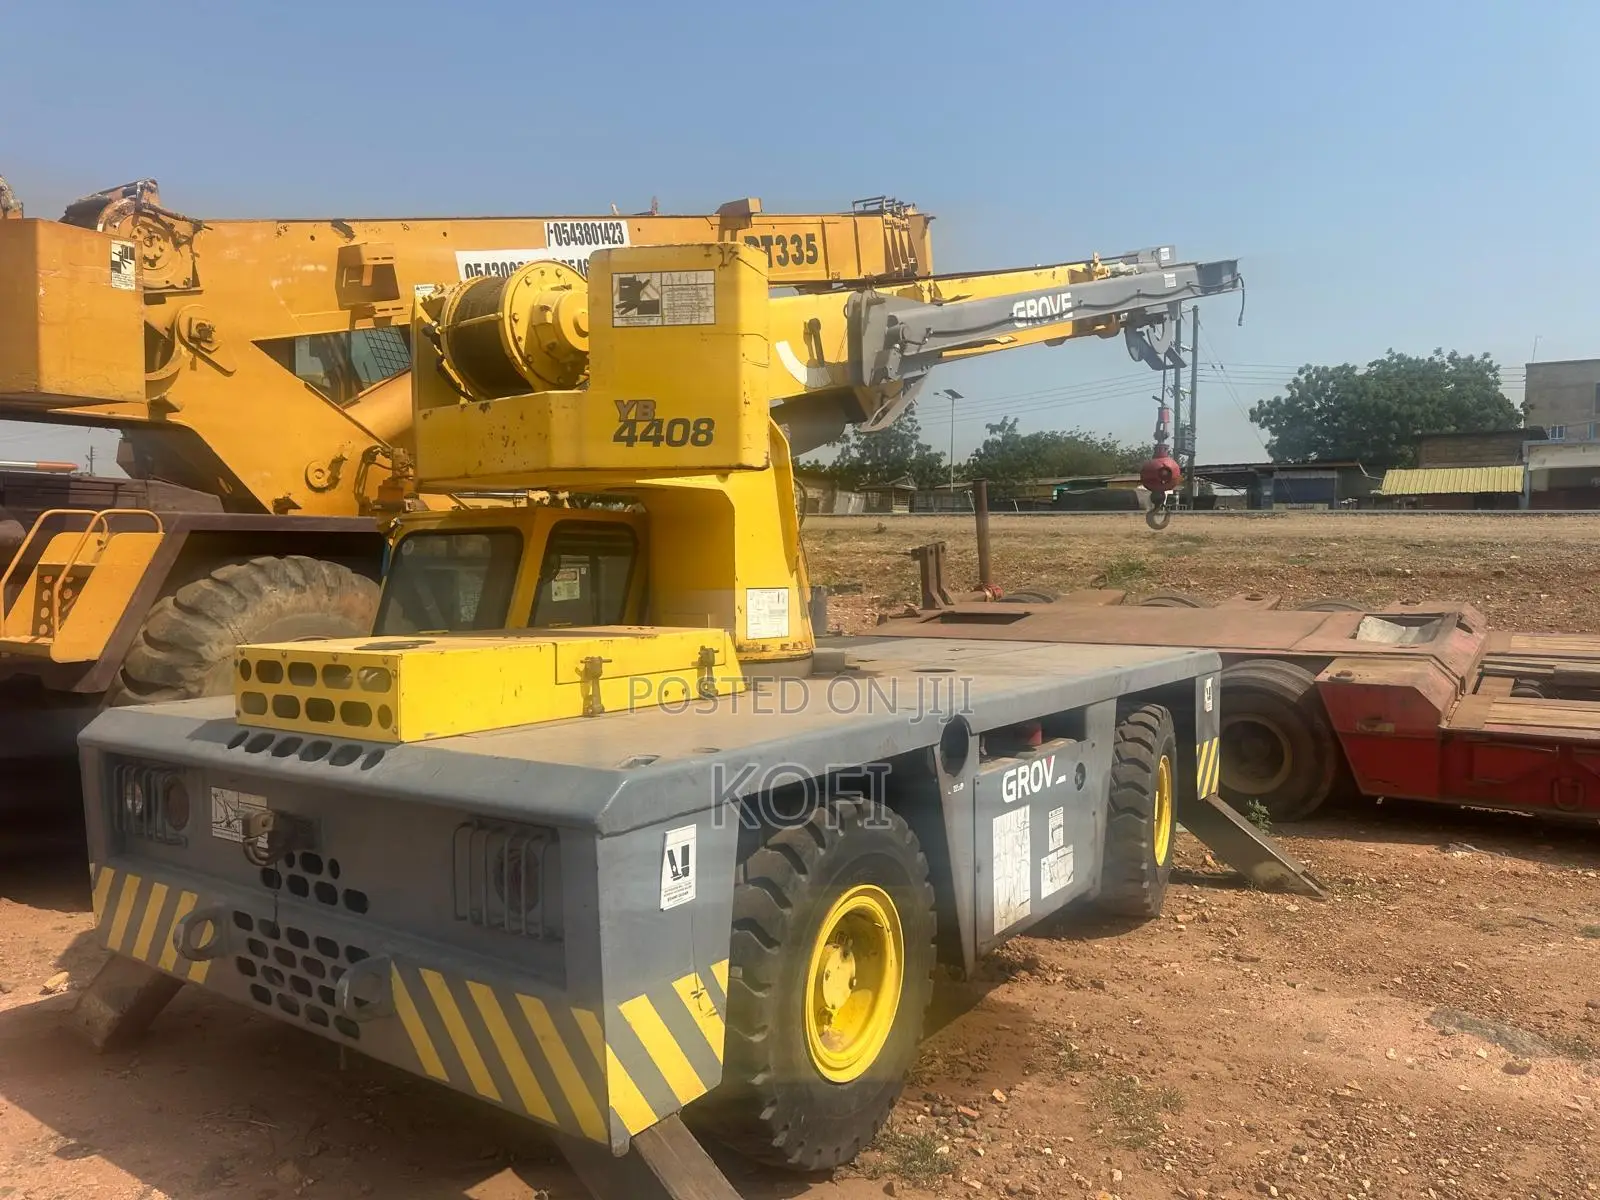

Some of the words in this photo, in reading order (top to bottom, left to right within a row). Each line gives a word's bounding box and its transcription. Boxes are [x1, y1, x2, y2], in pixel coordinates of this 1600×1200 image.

[1012, 292, 1074, 329] GROVE
[613, 400, 657, 422] YB
[612, 417, 716, 447] 4408
[1001, 755, 1067, 804] GROV
